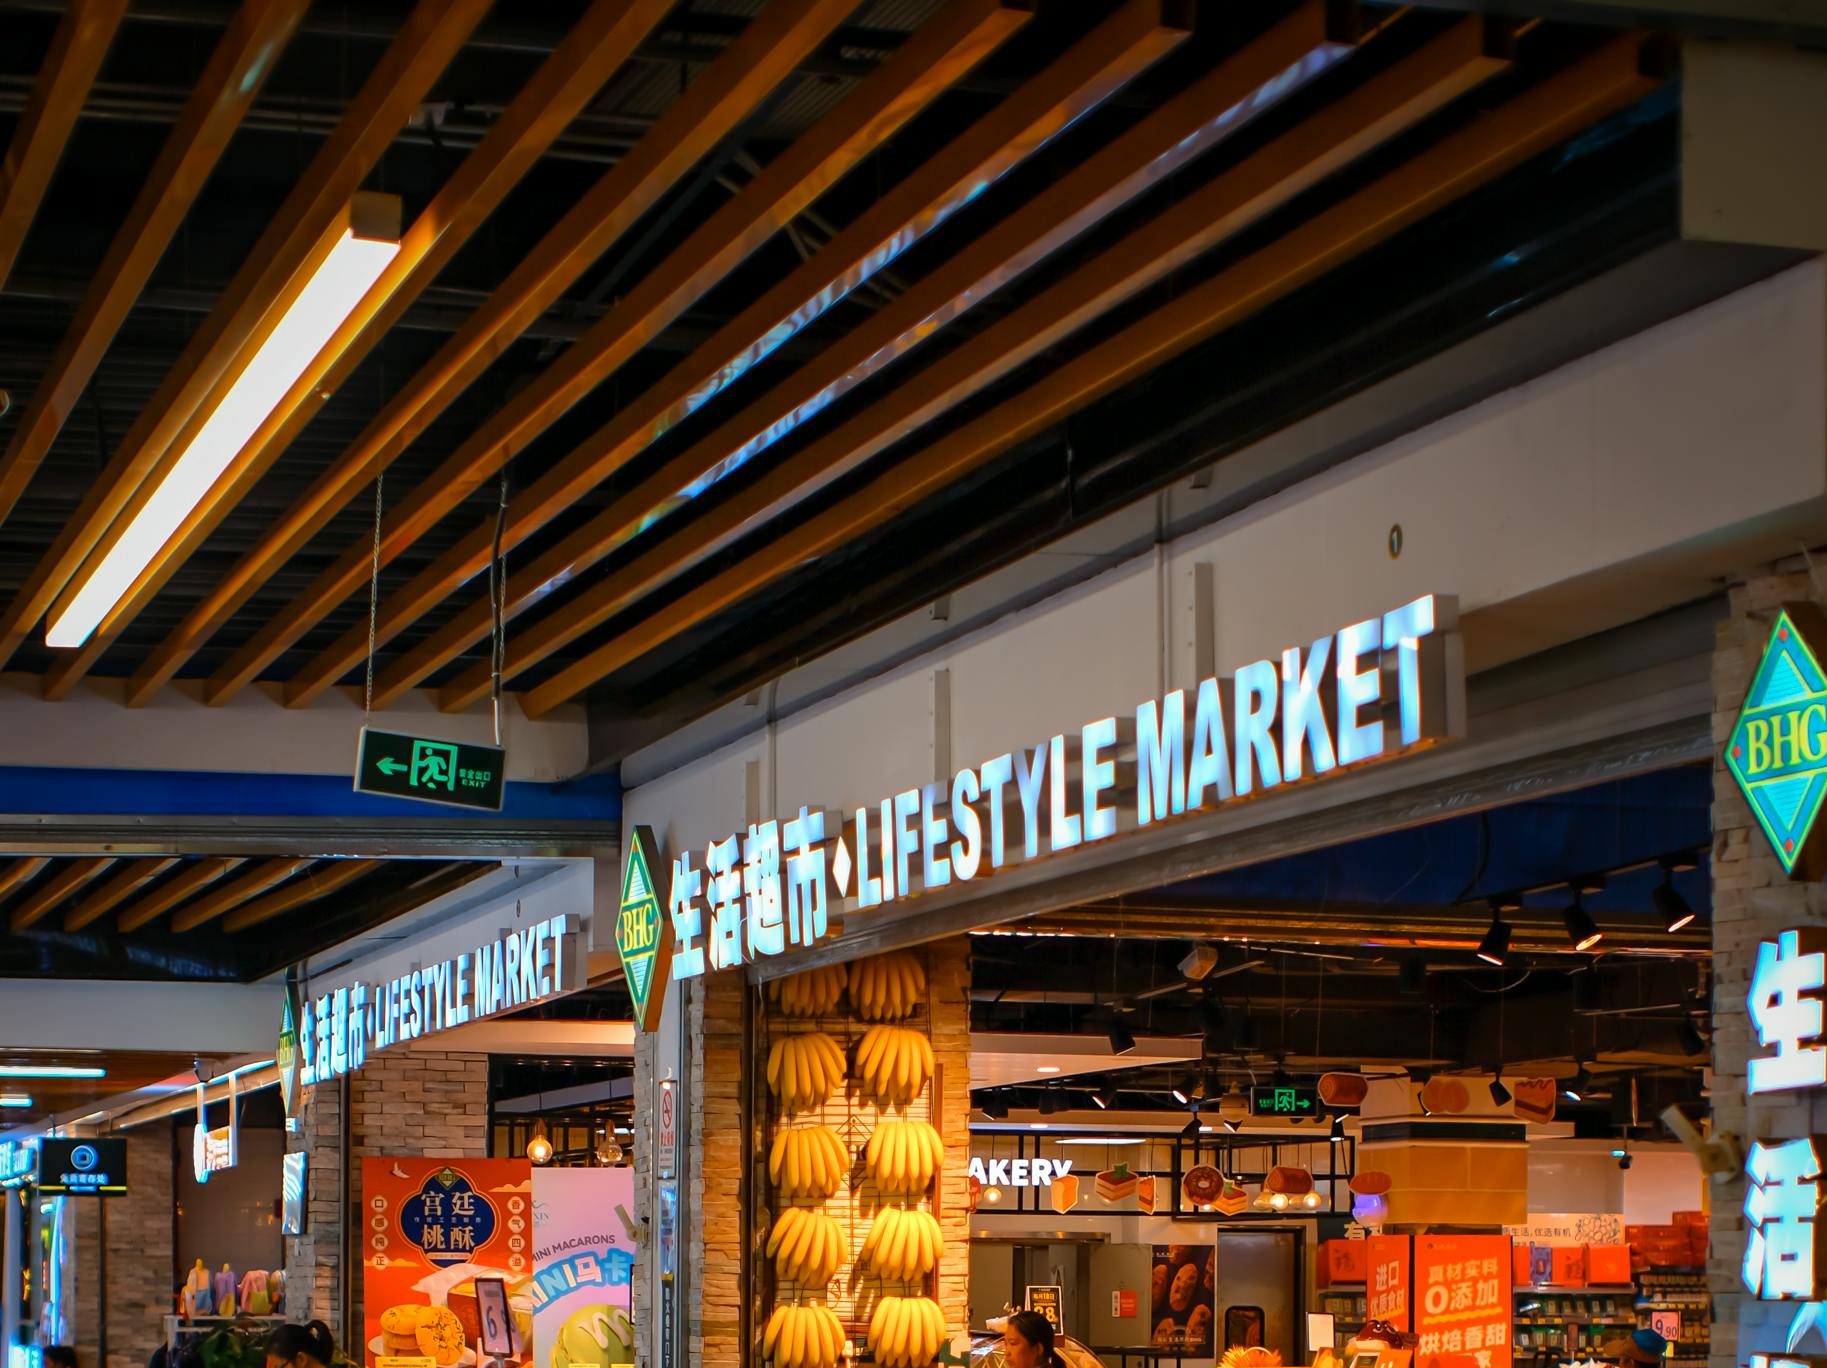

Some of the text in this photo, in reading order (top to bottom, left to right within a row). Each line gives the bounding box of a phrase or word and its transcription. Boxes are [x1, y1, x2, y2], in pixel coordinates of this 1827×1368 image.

[1746, 704, 1827, 774] BHG
[459, 768, 491, 781] 安全出口
[461, 779, 487, 788] EXIT
[669, 594, 1435, 981] 生活超市 LIFESTYLE MARKET
[622, 903, 655, 953] BHG
[300, 914, 567, 1086] 生活超市 LIFESTYLE MARKET
[421, 1191, 476, 1217] 宫廷
[421, 1224, 476, 1251] 桃酥
[510, 1200, 522, 1267] 香气四溢
[551, 1234, 616, 1254] MACARONS
[1376, 1261, 1399, 1291] 进口
[1428, 1257, 1499, 1285] 真材实料
[1425, 1279, 1499, 1314] 0添加
[1419, 1323, 1507, 1356] 烘焙香甜
